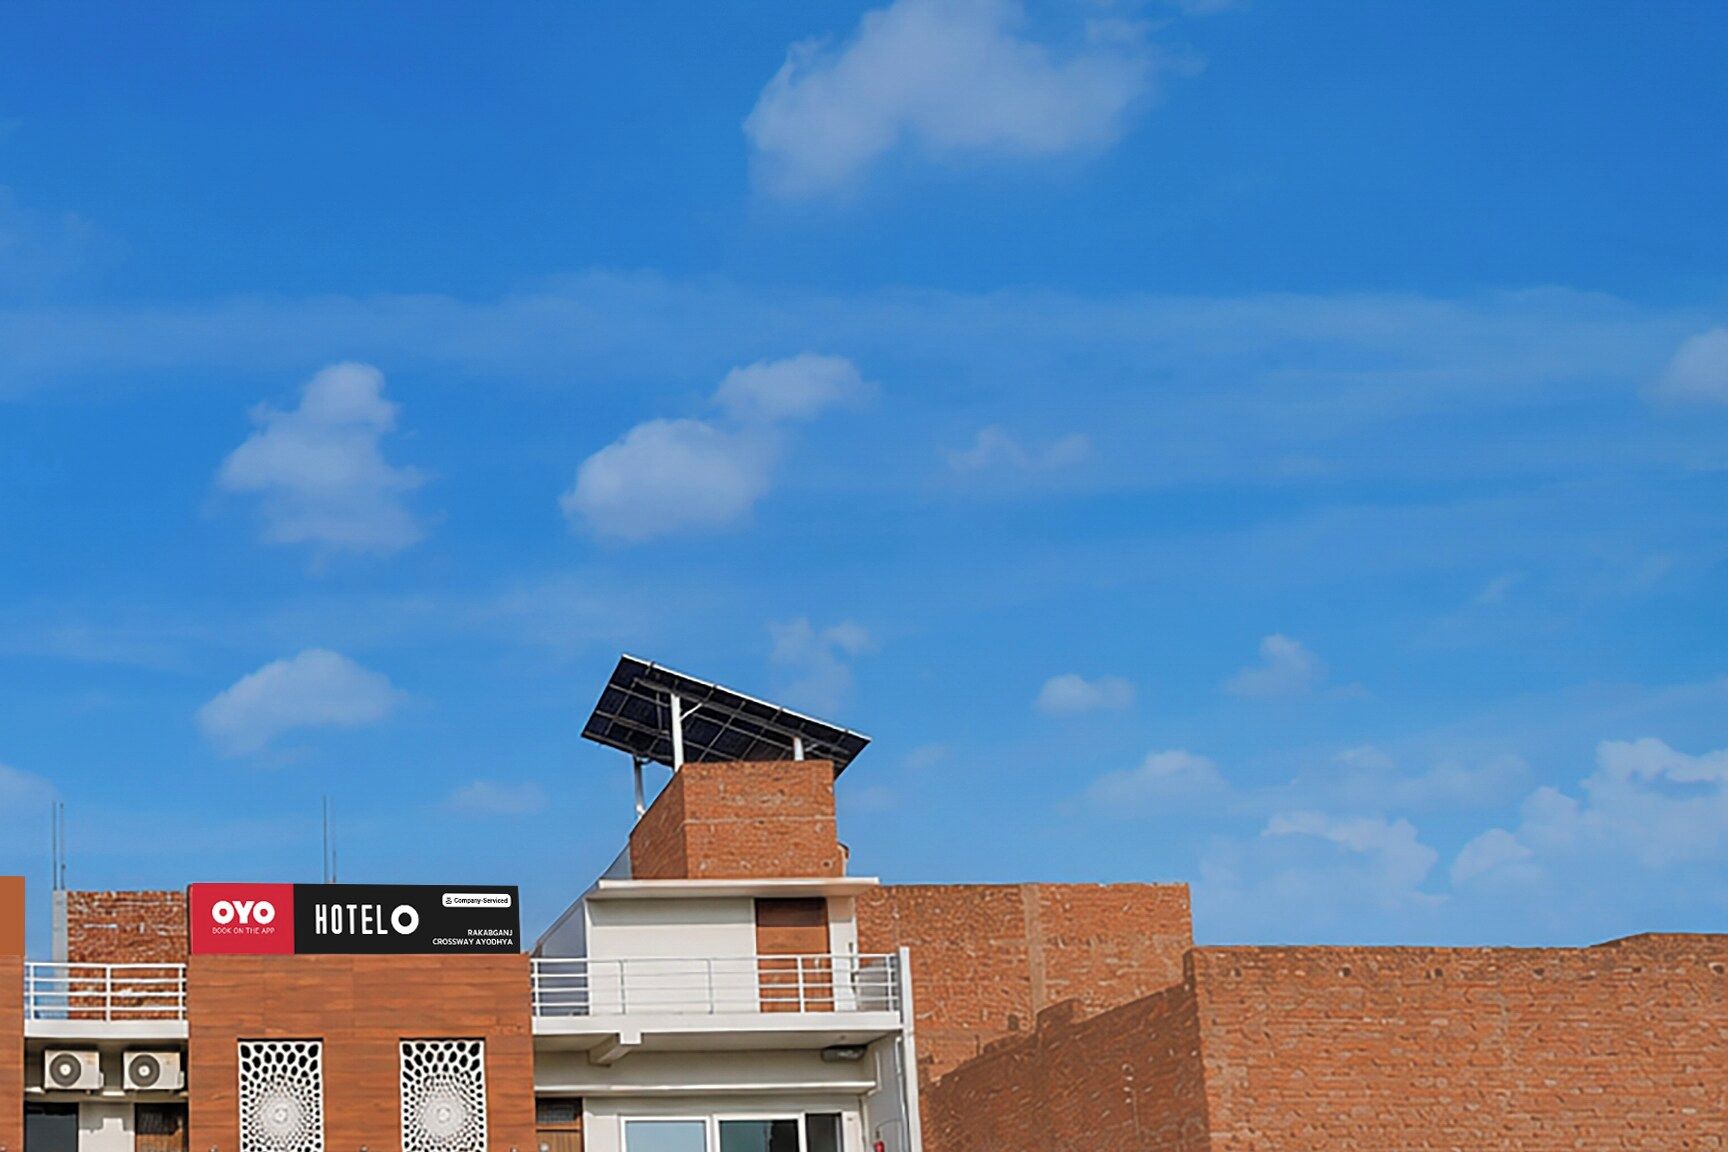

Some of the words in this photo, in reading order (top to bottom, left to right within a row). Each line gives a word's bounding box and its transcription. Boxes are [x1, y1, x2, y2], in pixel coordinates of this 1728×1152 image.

[453, 897, 508, 905] Company-Serviced
[211, 900, 276, 924] OYO
[212, 927, 231, 935] BOOK
[233, 927, 244, 935] ON
[246, 927, 259, 935] THE
[261, 927, 275, 935] APP
